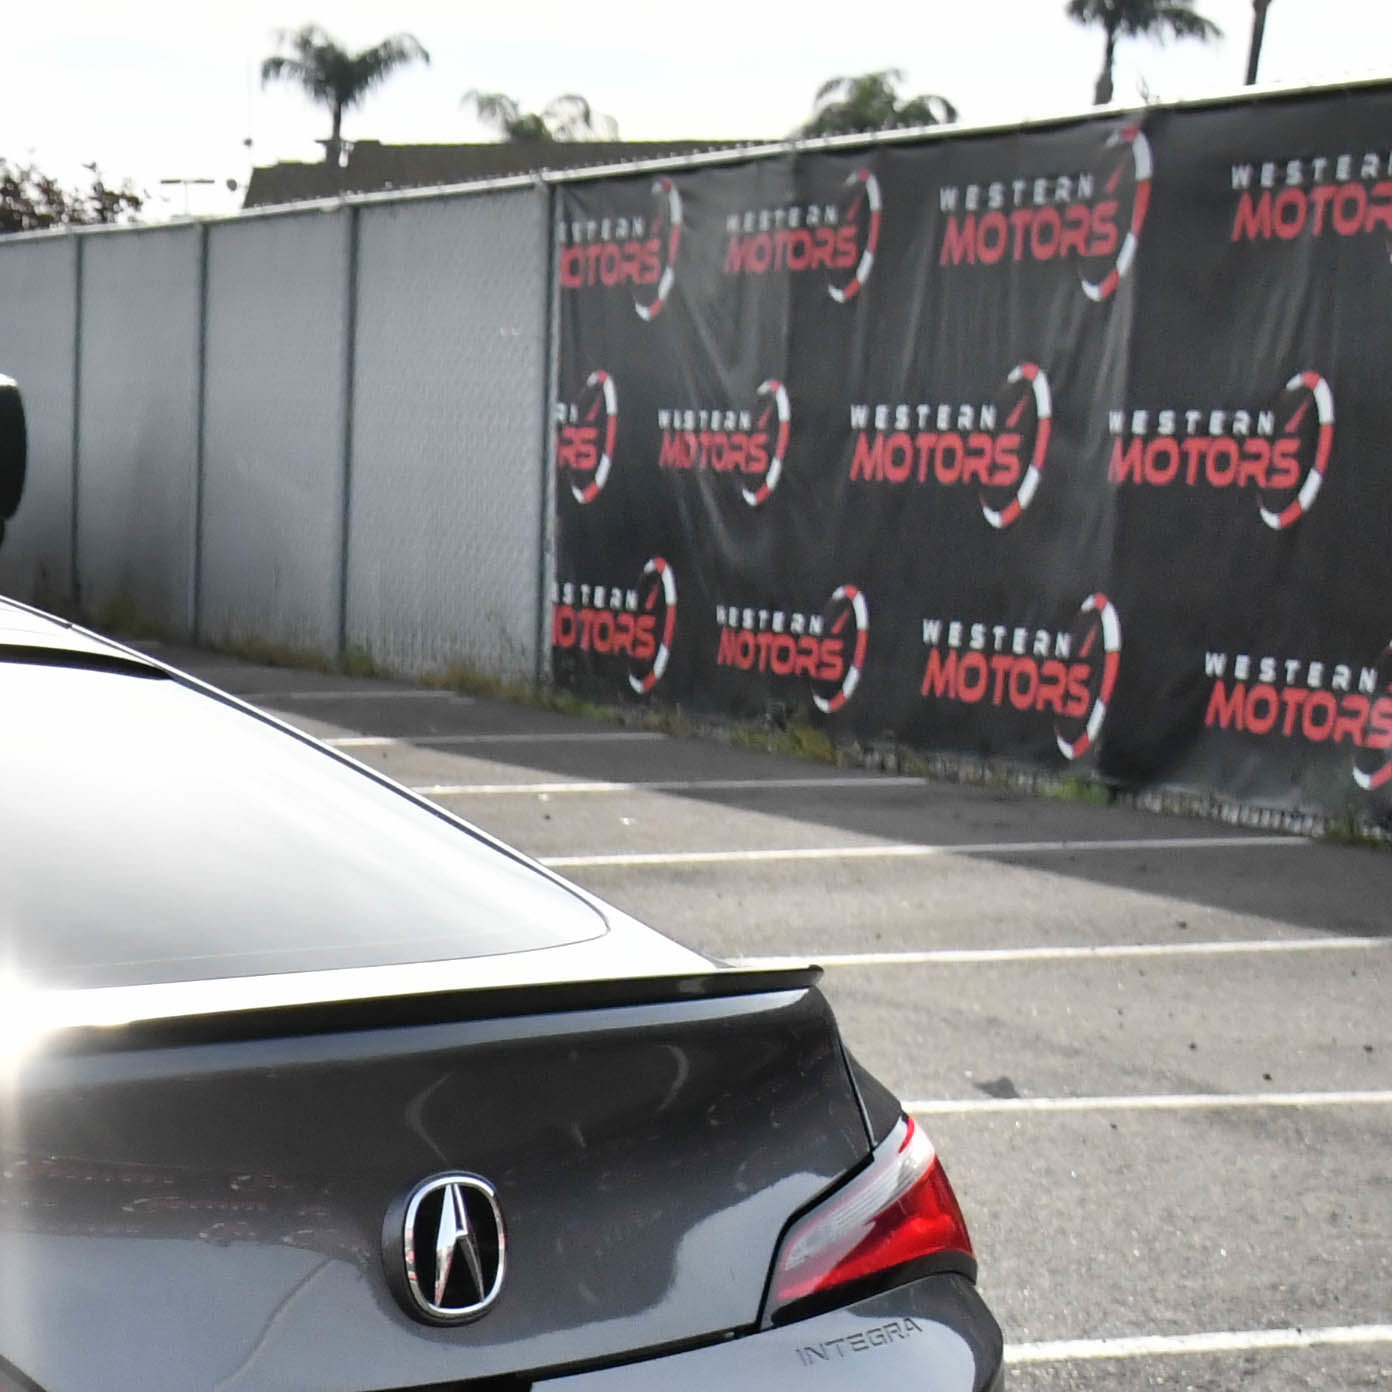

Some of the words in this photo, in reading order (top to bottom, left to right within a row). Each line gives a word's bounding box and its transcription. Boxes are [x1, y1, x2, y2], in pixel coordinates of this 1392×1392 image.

[940, 173, 1095, 212] WESTERN
[1231, 153, 1392, 190] WESTER
[726, 204, 839, 233] WESTERN
[939, 200, 1119, 267] MOTORS
[1231, 180, 1392, 243] MOTOR
[560, 240, 661, 288] OTORS
[724, 225, 858, 274] MOTORS
[658, 408, 752, 432] WESTERN
[850, 403, 998, 433] WESTERN
[1108, 409, 1276, 437] WESTERN
[658, 430, 769, 474] MOTORS
[849, 432, 1022, 486] MOTORS
[1107, 436, 1302, 489] MOTORS
[716, 604, 825, 637] WESTERN
[922, 618, 1073, 660] WESTERN
[717, 626, 844, 681] MOTORS
[1204, 651, 1379, 693] WESTERN
[921, 647, 1092, 719] MOTORS
[1204, 680, 1392, 750] MOTORS
[795, 1317, 924, 1367] INTEGRA
